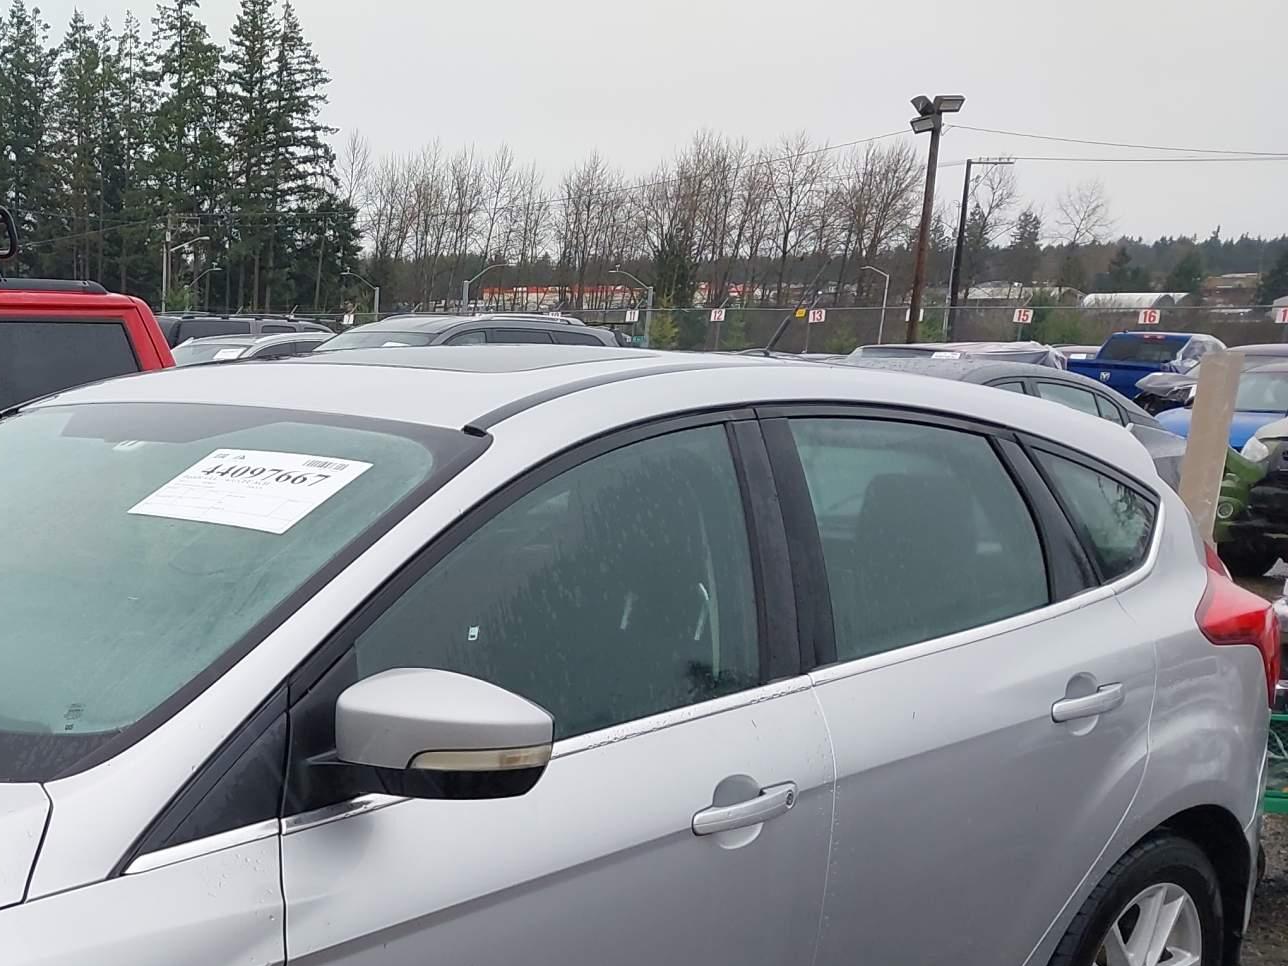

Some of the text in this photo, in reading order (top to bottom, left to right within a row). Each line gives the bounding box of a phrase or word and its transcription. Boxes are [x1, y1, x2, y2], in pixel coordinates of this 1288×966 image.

[628, 311, 637, 321] 11
[713, 310, 723, 320] 12
[812, 310, 823, 321] 13
[1017, 310, 1030, 322] 15
[1143, 310, 1157, 323] 16
[201, 463, 331, 487] 44097667
